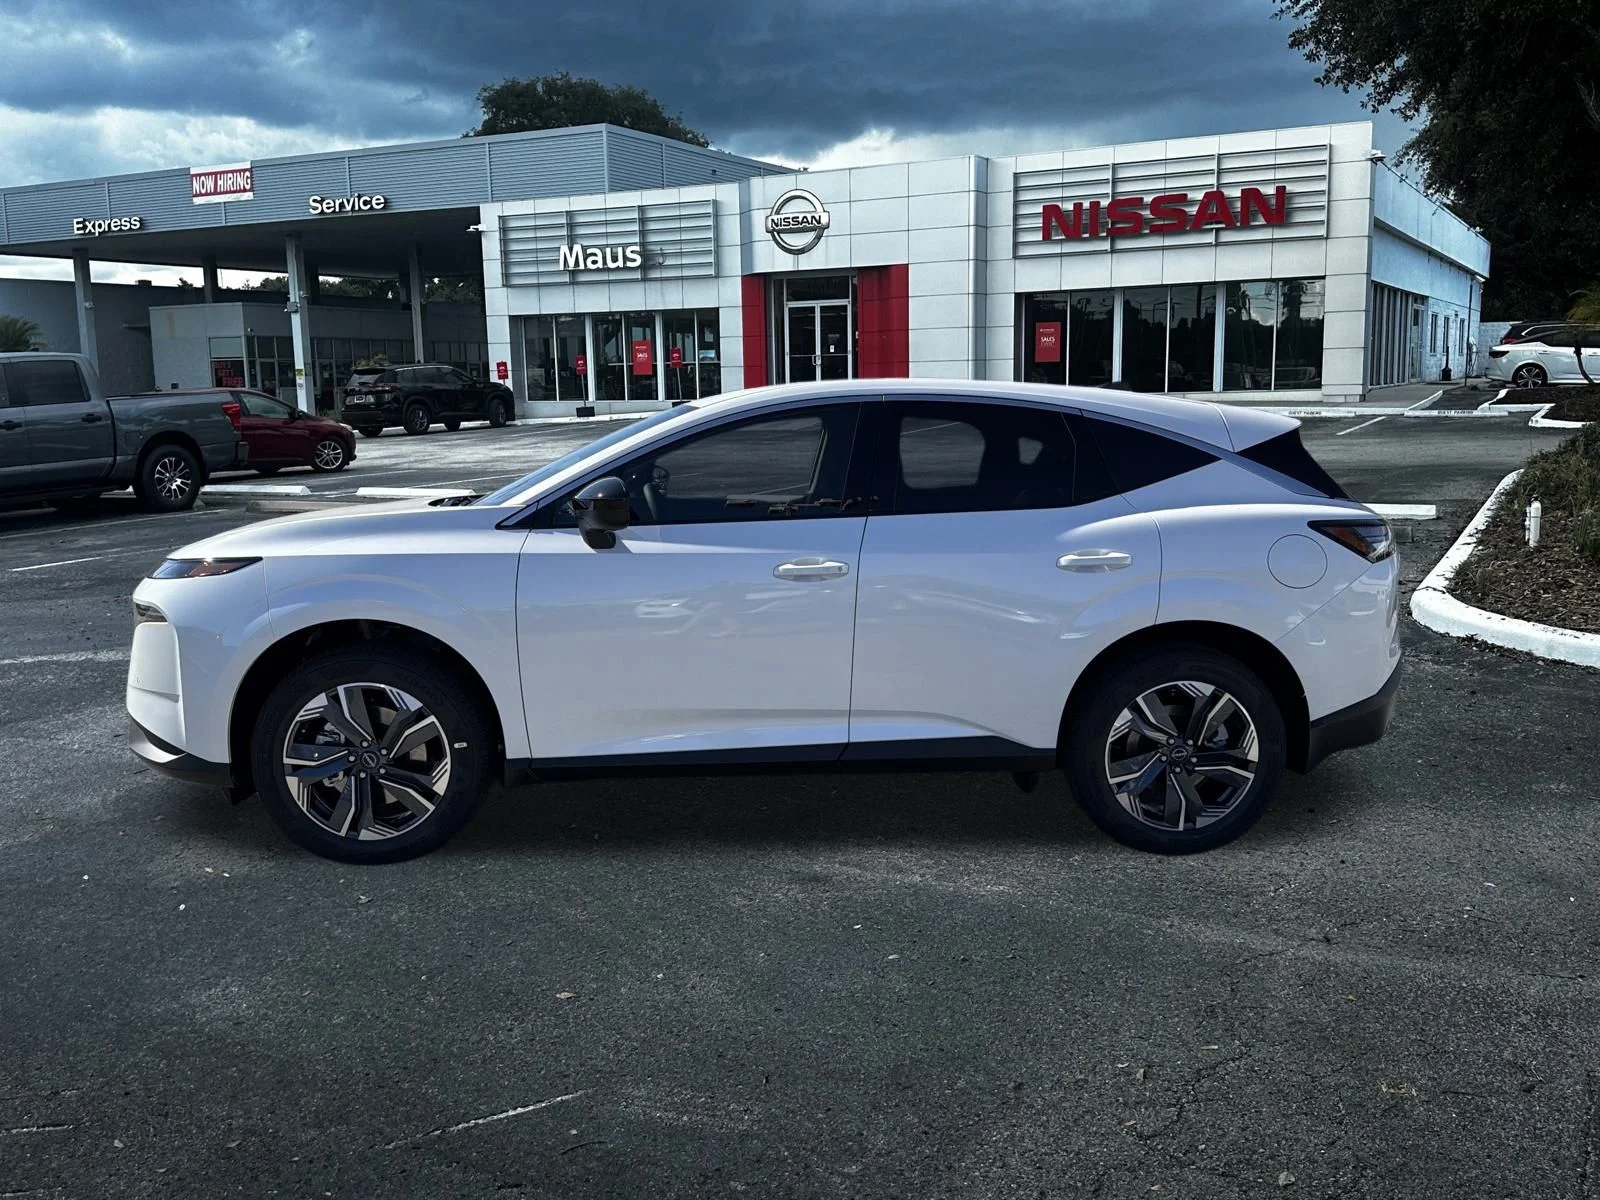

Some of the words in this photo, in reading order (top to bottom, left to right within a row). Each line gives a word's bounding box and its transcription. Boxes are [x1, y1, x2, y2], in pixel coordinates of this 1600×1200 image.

[192, 174, 215, 195] NOW
[217, 171, 251, 193] HIRING
[308, 193, 386, 216] Service
[1042, 185, 1287, 241] NISSAN
[73, 216, 141, 237] Express
[770, 215, 822, 229] NISSAN
[559, 244, 642, 271] Maus
